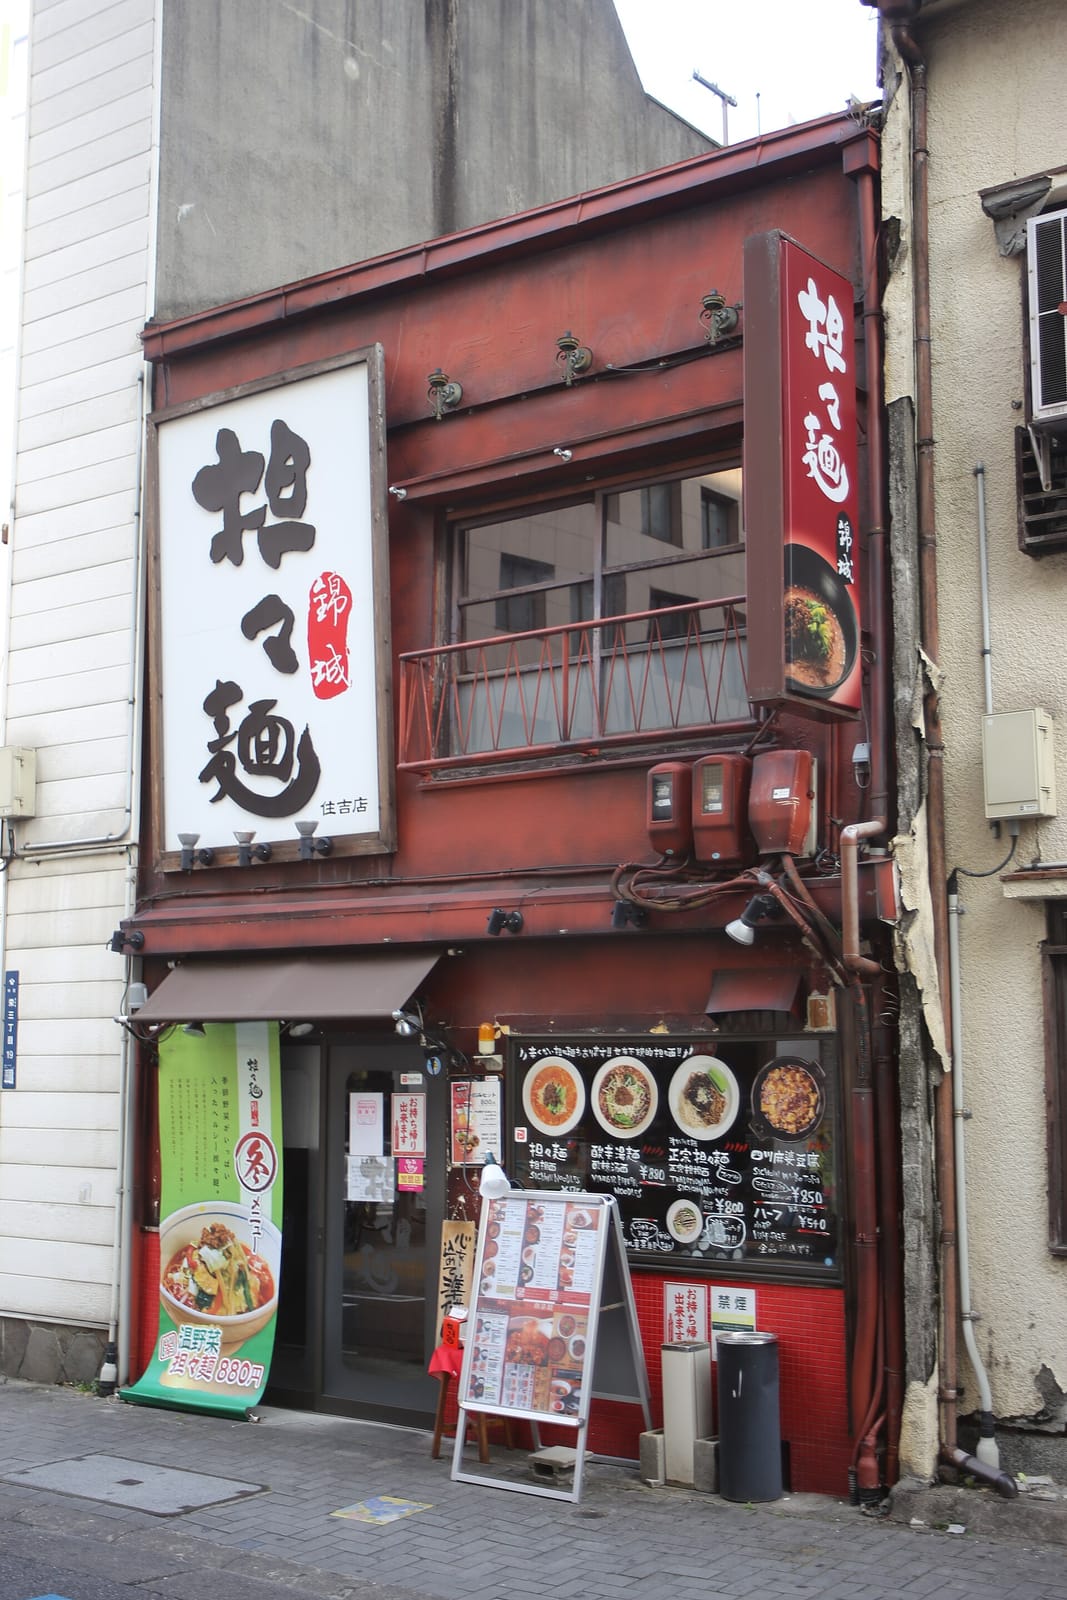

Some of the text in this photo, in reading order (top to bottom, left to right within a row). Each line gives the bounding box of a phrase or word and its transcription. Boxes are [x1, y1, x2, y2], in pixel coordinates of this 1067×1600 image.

[798, 278, 849, 503] 担々麺
[838, 519, 854, 585] 錦城
[192, 419, 321, 818] 担々麺
[311, 575, 352, 688] 錦城
[320, 797, 368, 816] 住吉店
[400, 1102, 409, 1145] 出来ます
[409, 1098, 418, 1151] お持ち帰り
[245, 1140, 270, 1185] 冬
[528, 1142, 568, 1161] 担々麺
[750, 1149, 820, 1168] 四川麻婆豆腐
[753, 1207, 783, 1221] ハーフ
[790, 1186, 823, 1204] ¥850
[249, 1197, 262, 1253] メニュー
[718, 1294, 747, 1311] 禁煙
[179, 1326, 222, 1354] 温野菜
[169, 1352, 263, 1388] 担々麺 880円
